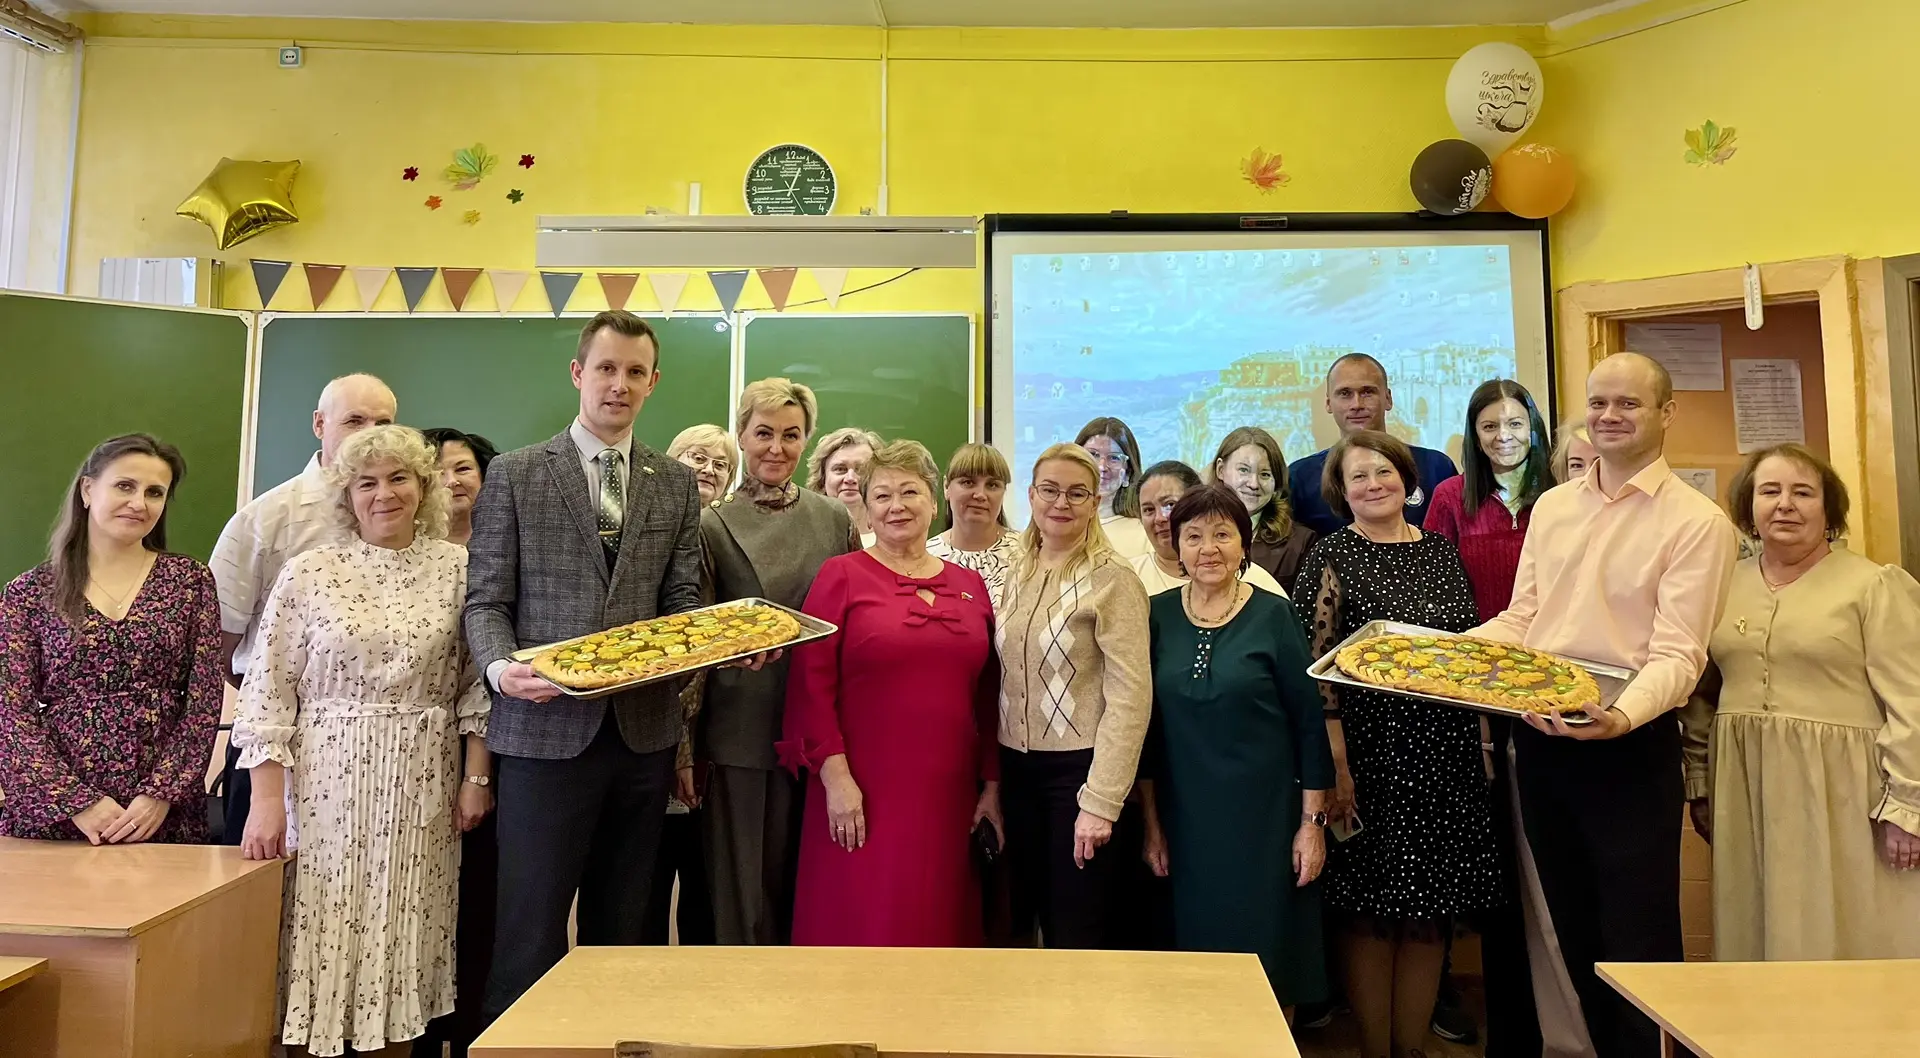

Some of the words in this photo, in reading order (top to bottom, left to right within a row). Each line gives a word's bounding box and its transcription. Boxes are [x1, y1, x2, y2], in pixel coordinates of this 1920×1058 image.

[785, 150, 796, 160] 12
[805, 155, 810, 164] 1
[767, 156, 778, 165] 11
[755, 169, 767, 178] 10
[820, 170, 826, 179] 2
[751, 186, 757, 195] 9
[824, 185, 830, 195] 3
[757, 204, 763, 215] 8
[818, 203, 825, 213] 4
